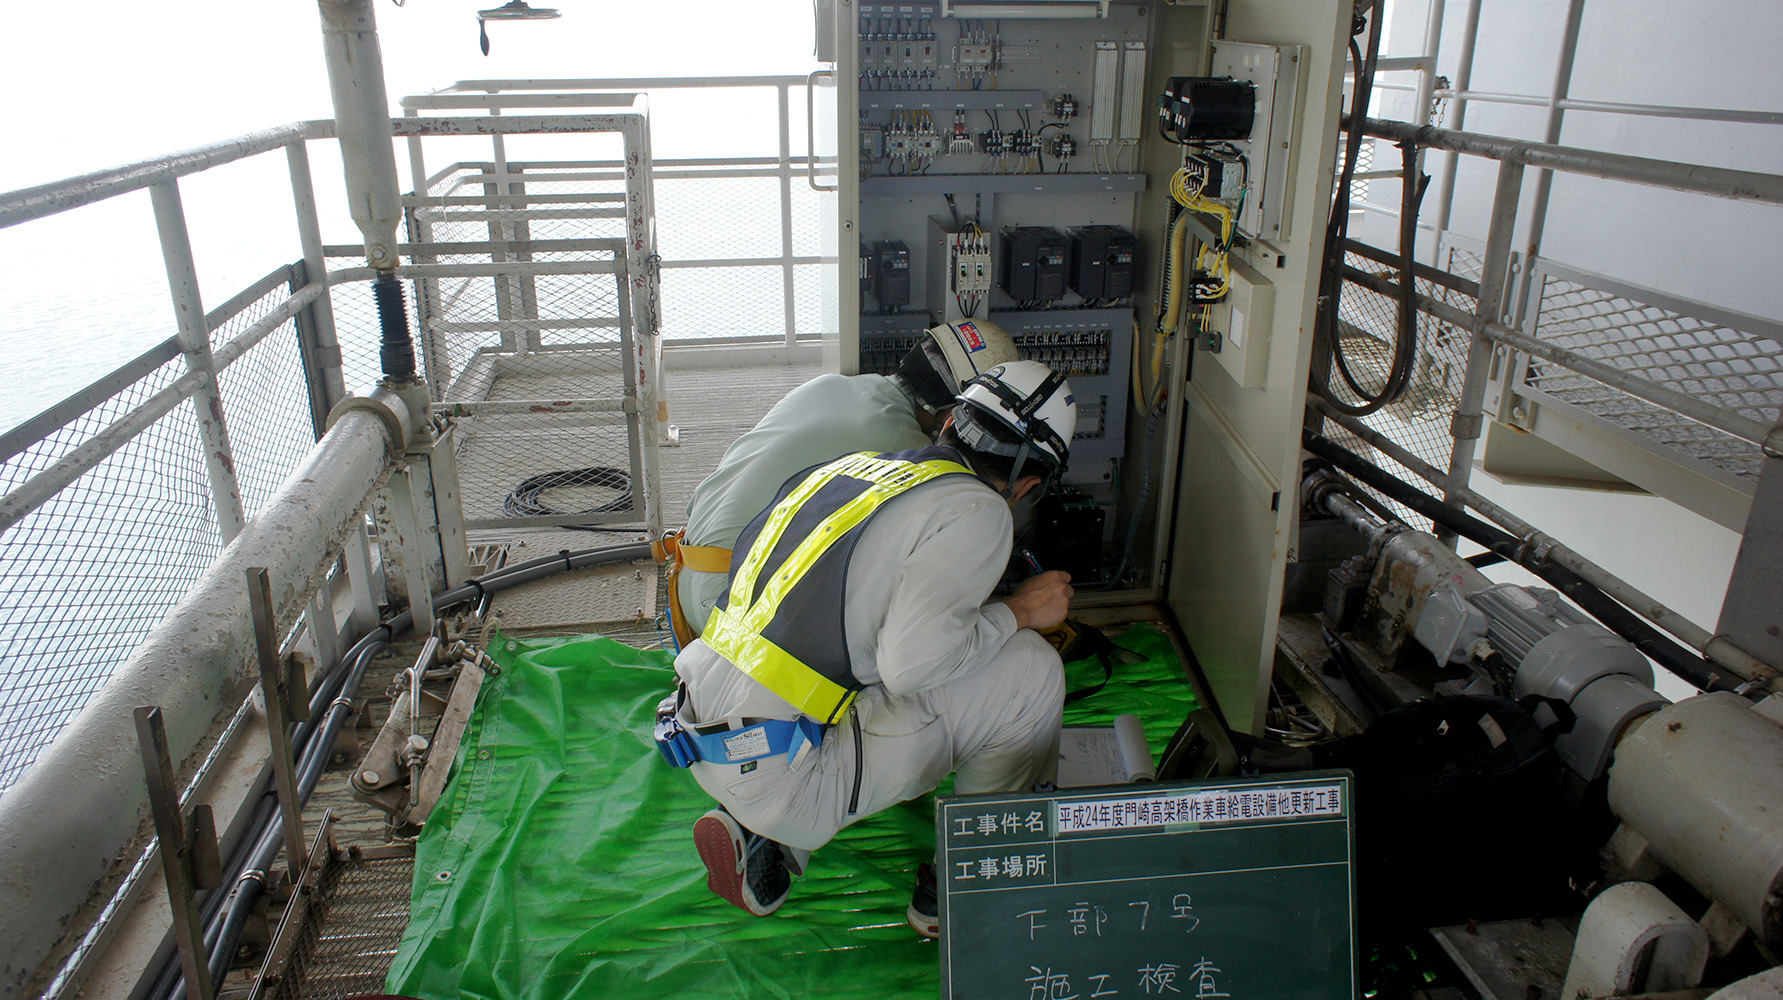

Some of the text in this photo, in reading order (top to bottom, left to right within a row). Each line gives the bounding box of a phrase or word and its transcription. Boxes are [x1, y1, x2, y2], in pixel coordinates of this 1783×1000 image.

[953, 788, 1340, 837] 工事件名 平成24年度門崎高架橋作業車給電設備他更新工事
[955, 854, 1047, 880] 工事場所
